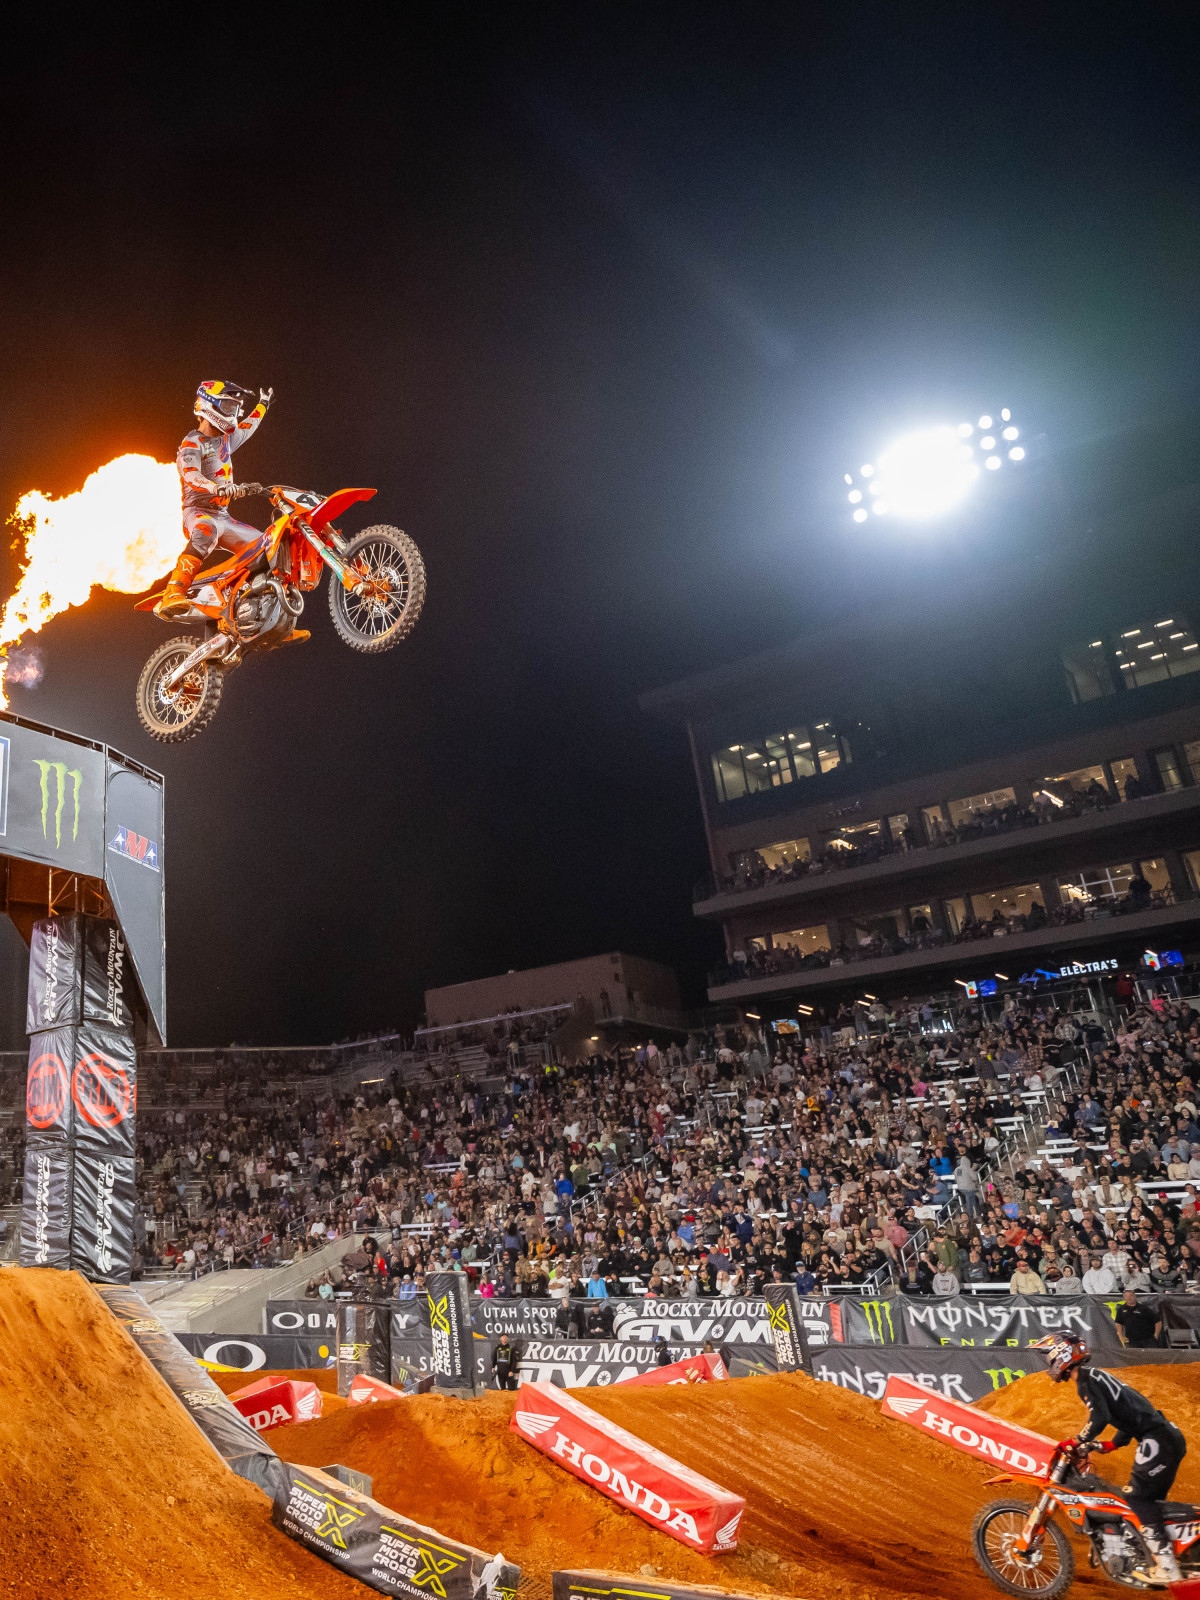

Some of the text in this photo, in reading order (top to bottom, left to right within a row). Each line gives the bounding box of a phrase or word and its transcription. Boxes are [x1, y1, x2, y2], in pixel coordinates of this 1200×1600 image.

[108, 824, 160, 869] AMA
[106, 927, 116, 1011] ROCKY MOUNTAIN
[1060, 958, 1119, 977] ELECTRA'S
[483, 1307, 558, 1319] UTAH SPOR
[641, 1300, 827, 1318] ROCKY MOUNIN
[906, 1301, 1092, 1332] MONSTER
[449, 1290, 462, 1376] WORLD CHAMPIONSHIP
[485, 1322, 553, 1335] COMMISSI
[441, 1329, 452, 1377] CROSS
[522, 1341, 593, 1362] ROCKY
[922, 1410, 1049, 1479] HONDA
[289, 1486, 328, 1514] SUPER
[550, 1431, 704, 1545] HONDA
[285, 1504, 321, 1531] CROSS
[289, 1496, 323, 1521] MOTO
[282, 1518, 351, 1560] WORLD CHAMPIONSHIP
[379, 1533, 422, 1559] SUPER
[372, 1552, 417, 1579] CROSS
[378, 1543, 417, 1568] MOTO
[371, 1567, 440, 1600] WORLD CHAMPION
